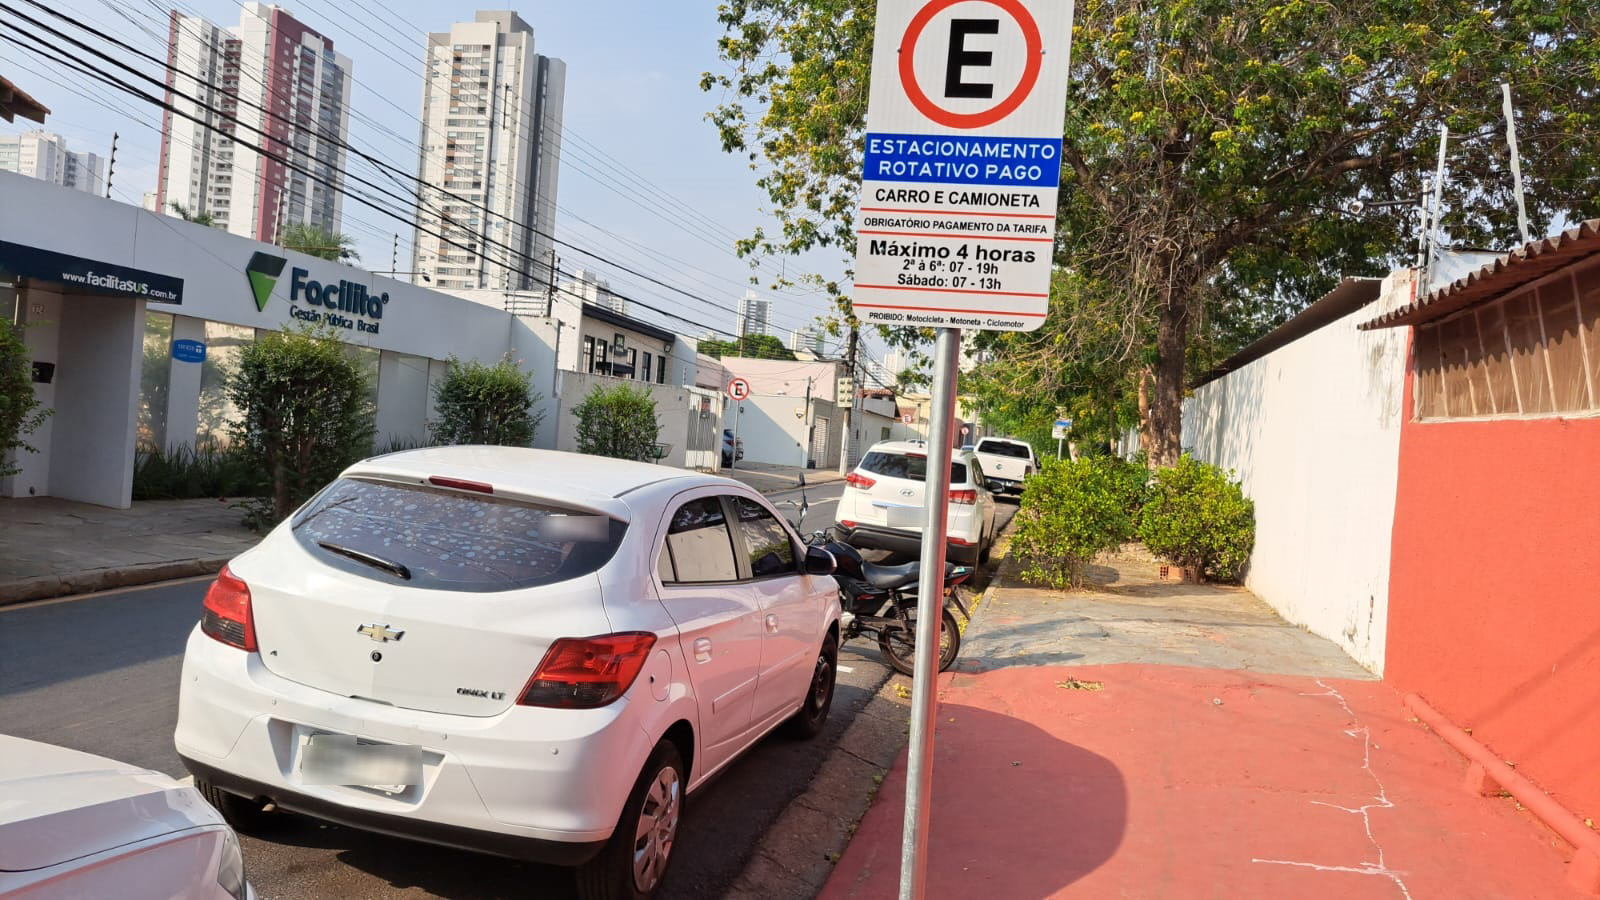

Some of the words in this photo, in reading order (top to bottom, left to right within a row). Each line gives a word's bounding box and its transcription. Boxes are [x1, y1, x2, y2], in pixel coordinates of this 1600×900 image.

[945, 19, 999, 98] E
[870, 139, 1055, 159] ESTACIONAMENTO
[879, 161, 979, 179] ROTATIVO
[985, 165, 1042, 180] PAGO
[875, 188, 930, 203] CARRO
[934, 191, 944, 204] E
[949, 191, 1040, 207] CAMIONETA
[864, 217, 931, 229] OBRIGATÓRIO
[932, 221, 994, 231] PAGAMENTO
[996, 223, 1011, 232] DA
[1012, 224, 1047, 234] TARIFA
[870, 240, 950, 260] Máximo
[956, 244, 969, 260] 4
[976, 245, 1036, 263] horas
[949, 261, 965, 273] 07
[976, 262, 999, 275] 19h
[897, 273, 948, 287] Sábado:
[952, 276, 967, 288] 07
[980, 278, 1002, 290] 13h
[357, 319, 379, 334] Brasil
[868, 312, 905, 322] PROIBIDO:
[906, 314, 944, 324] Motocicleta
[949, 317, 981, 326] Motoneta
[986, 318, 1025, 328] Ciclomotor
